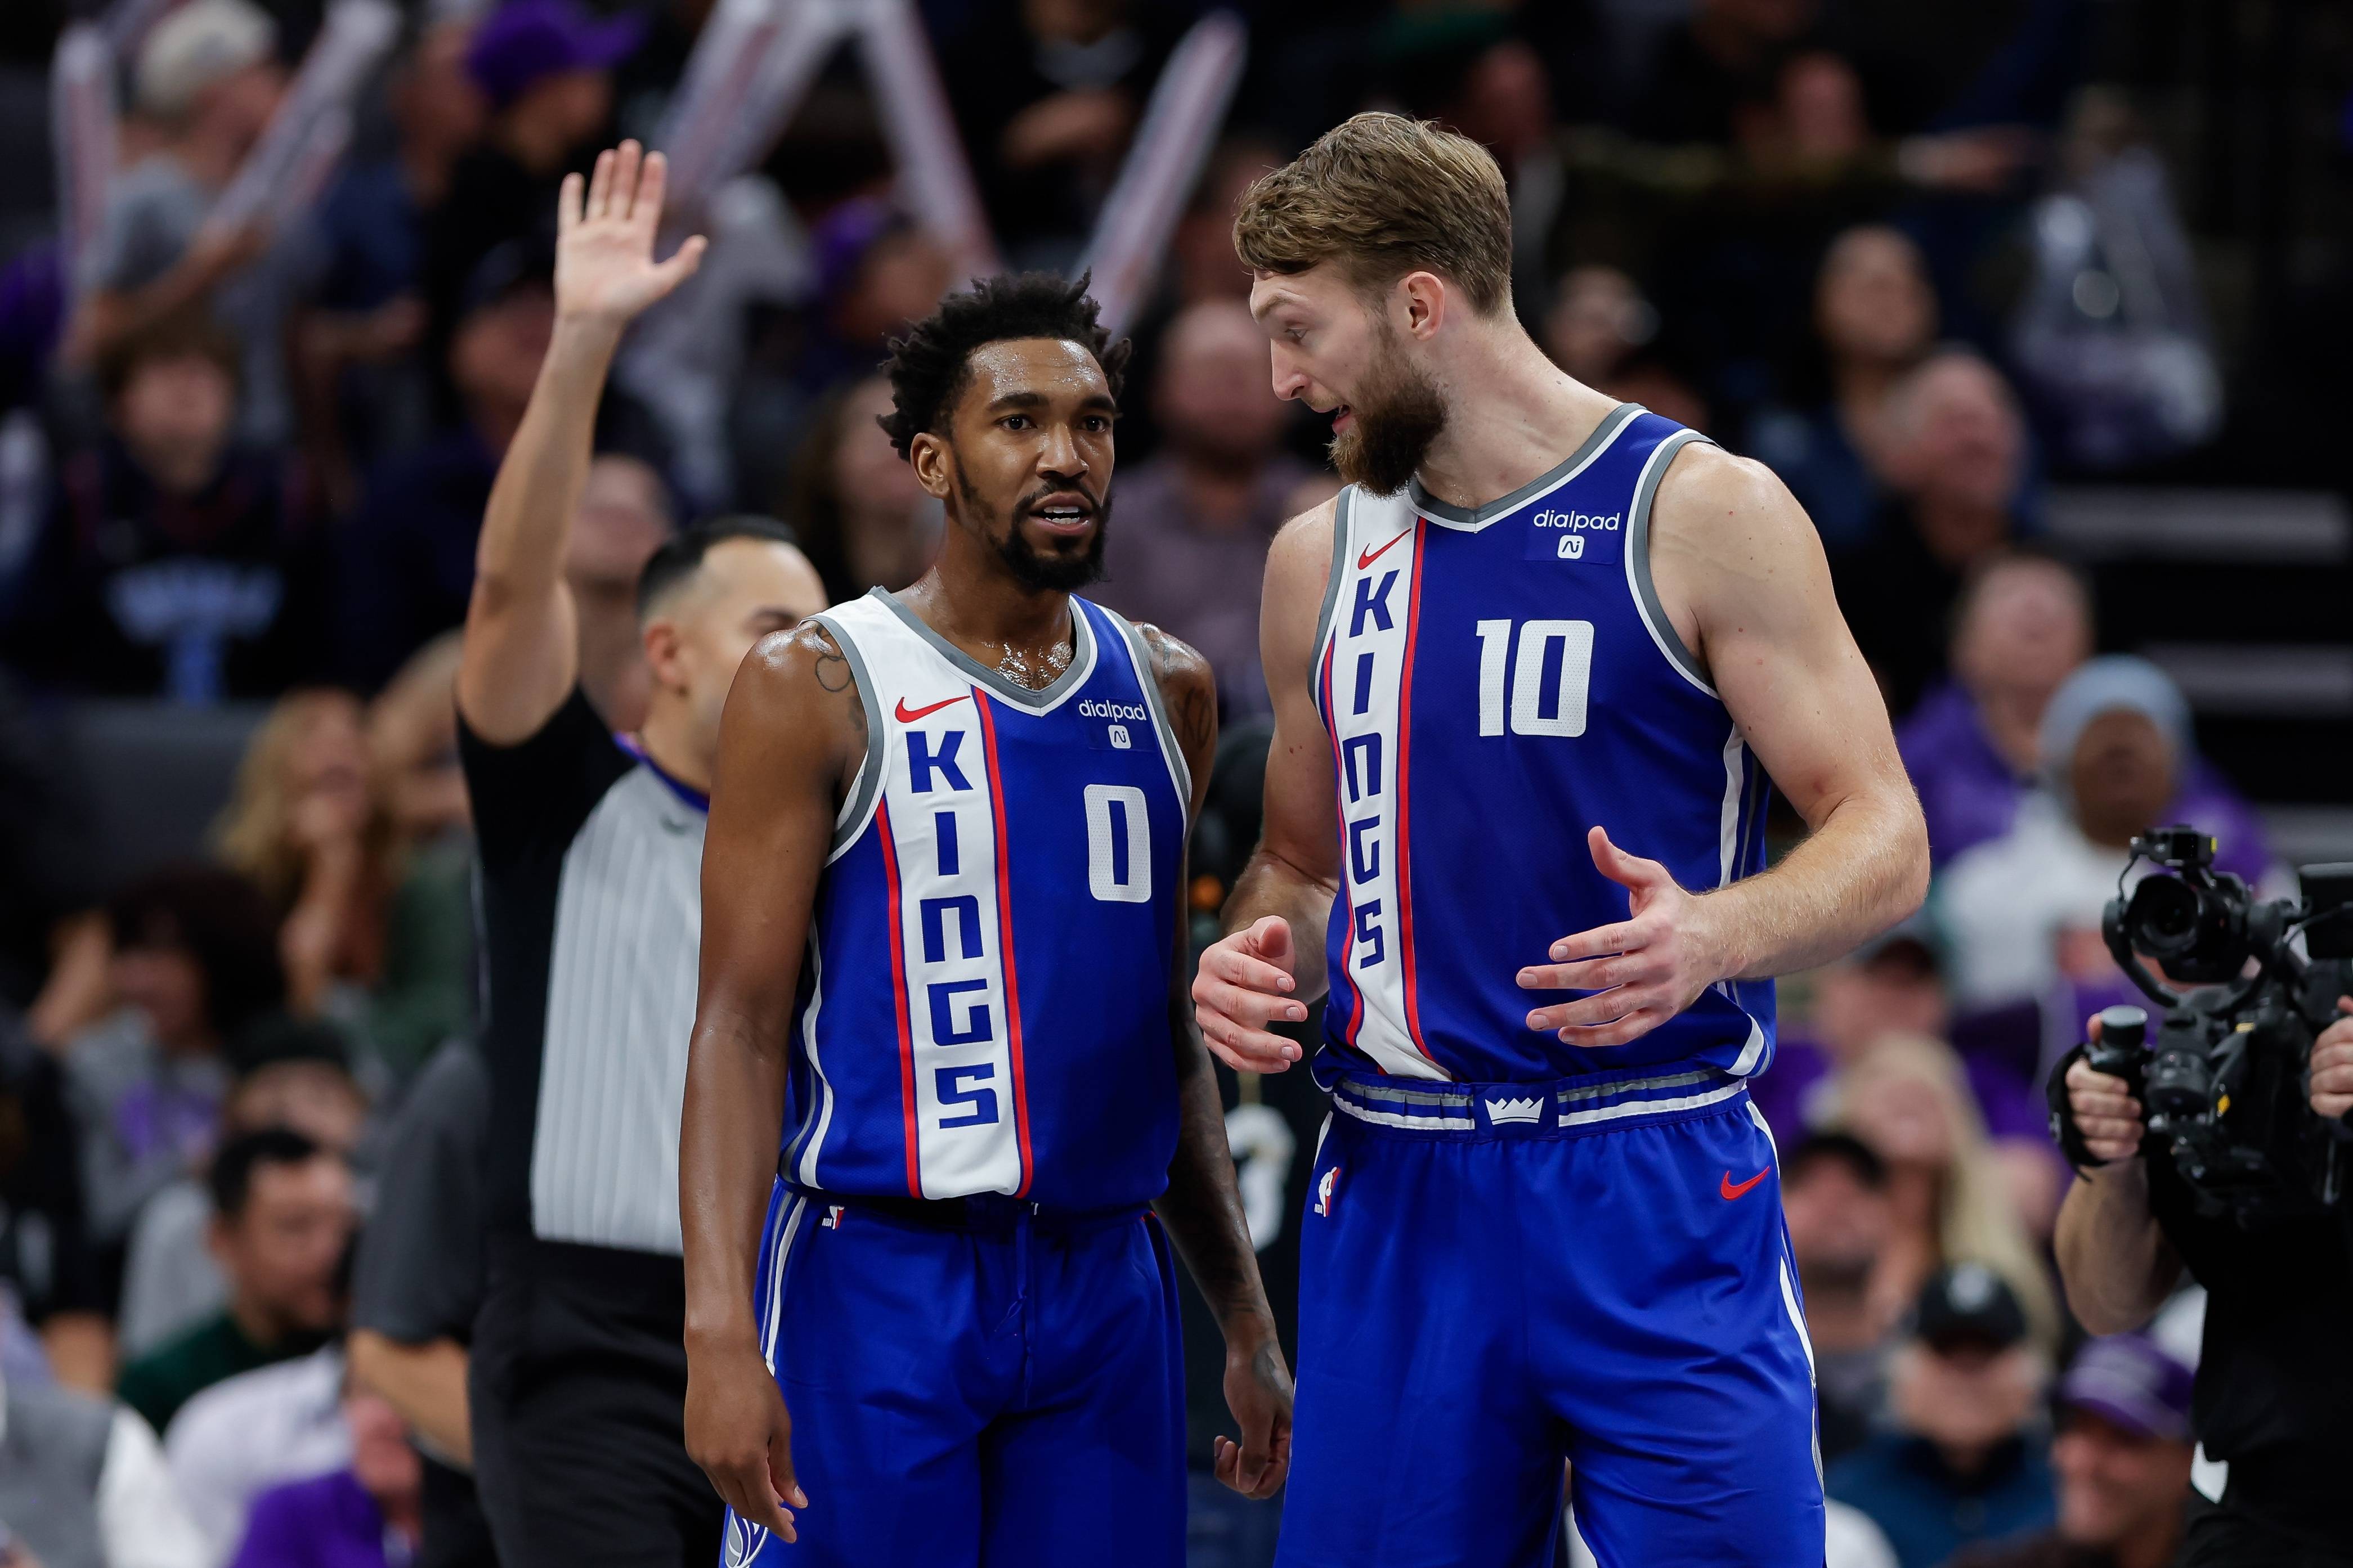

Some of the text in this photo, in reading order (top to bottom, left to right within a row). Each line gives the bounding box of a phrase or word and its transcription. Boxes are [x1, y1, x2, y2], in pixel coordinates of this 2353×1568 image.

[1534, 509, 1620, 533] dialpad
[1078, 699, 1147, 723] dialpad
[1476, 618, 1595, 738] 10
[1084, 784, 1152, 904] 0
